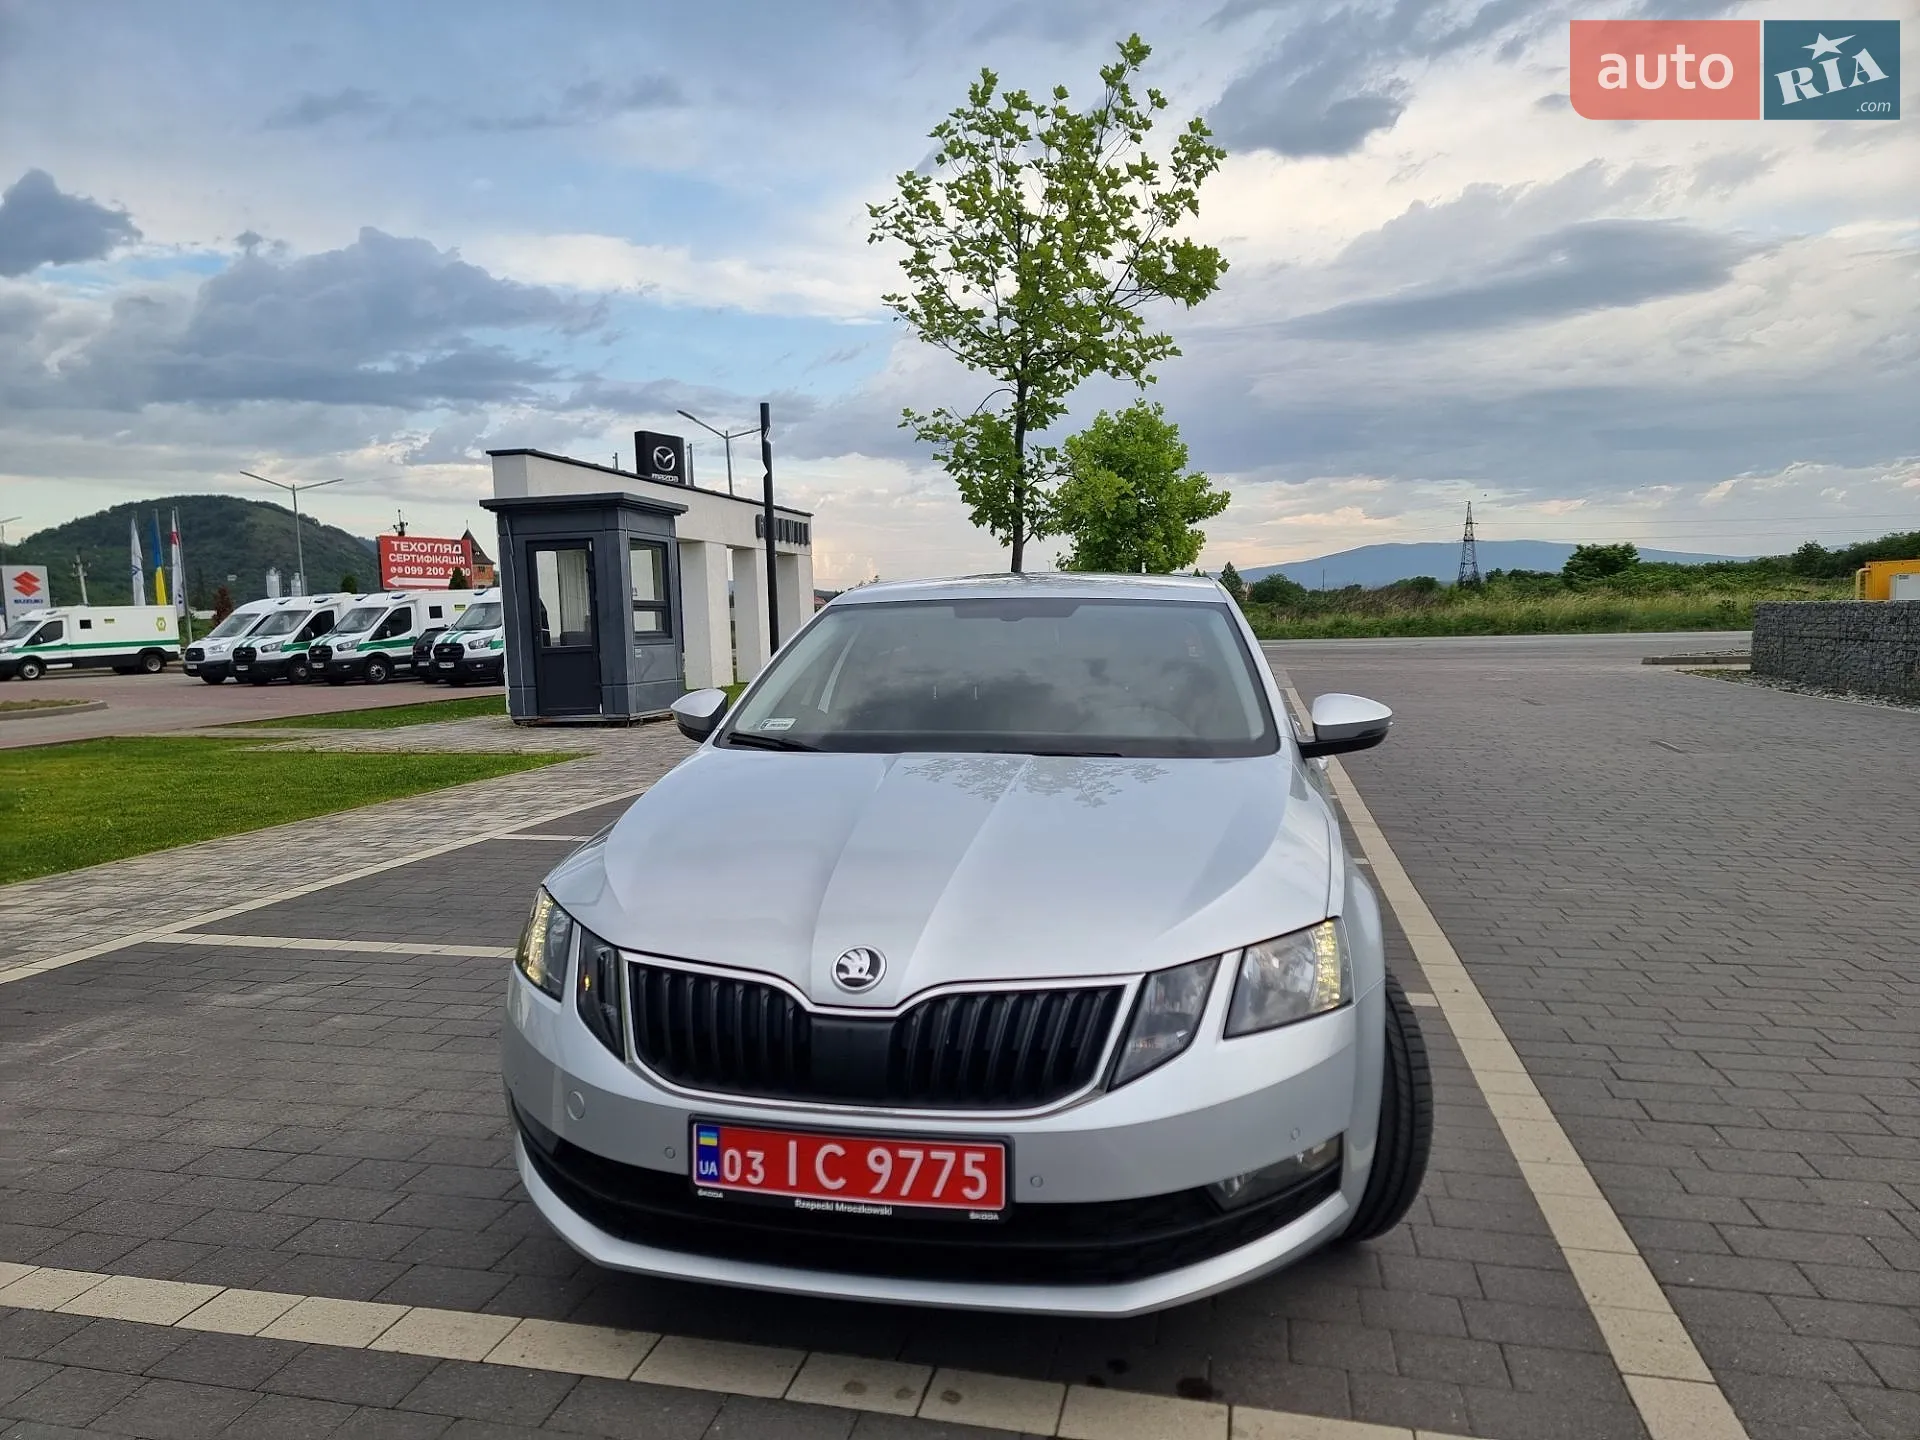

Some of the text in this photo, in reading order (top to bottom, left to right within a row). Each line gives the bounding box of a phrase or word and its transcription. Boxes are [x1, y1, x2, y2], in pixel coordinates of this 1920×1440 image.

[391, 541, 462, 554] ТЕХОГЛЯД
[388, 553, 466, 565] СЕРТИФІКАЦІЯ
[404, 566, 423, 575] 099
[427, 567, 445, 576] 200
[699, 1160, 718, 1176] UA
[723, 1148, 765, 1185] 03
[866, 1146, 988, 1201] 9775
